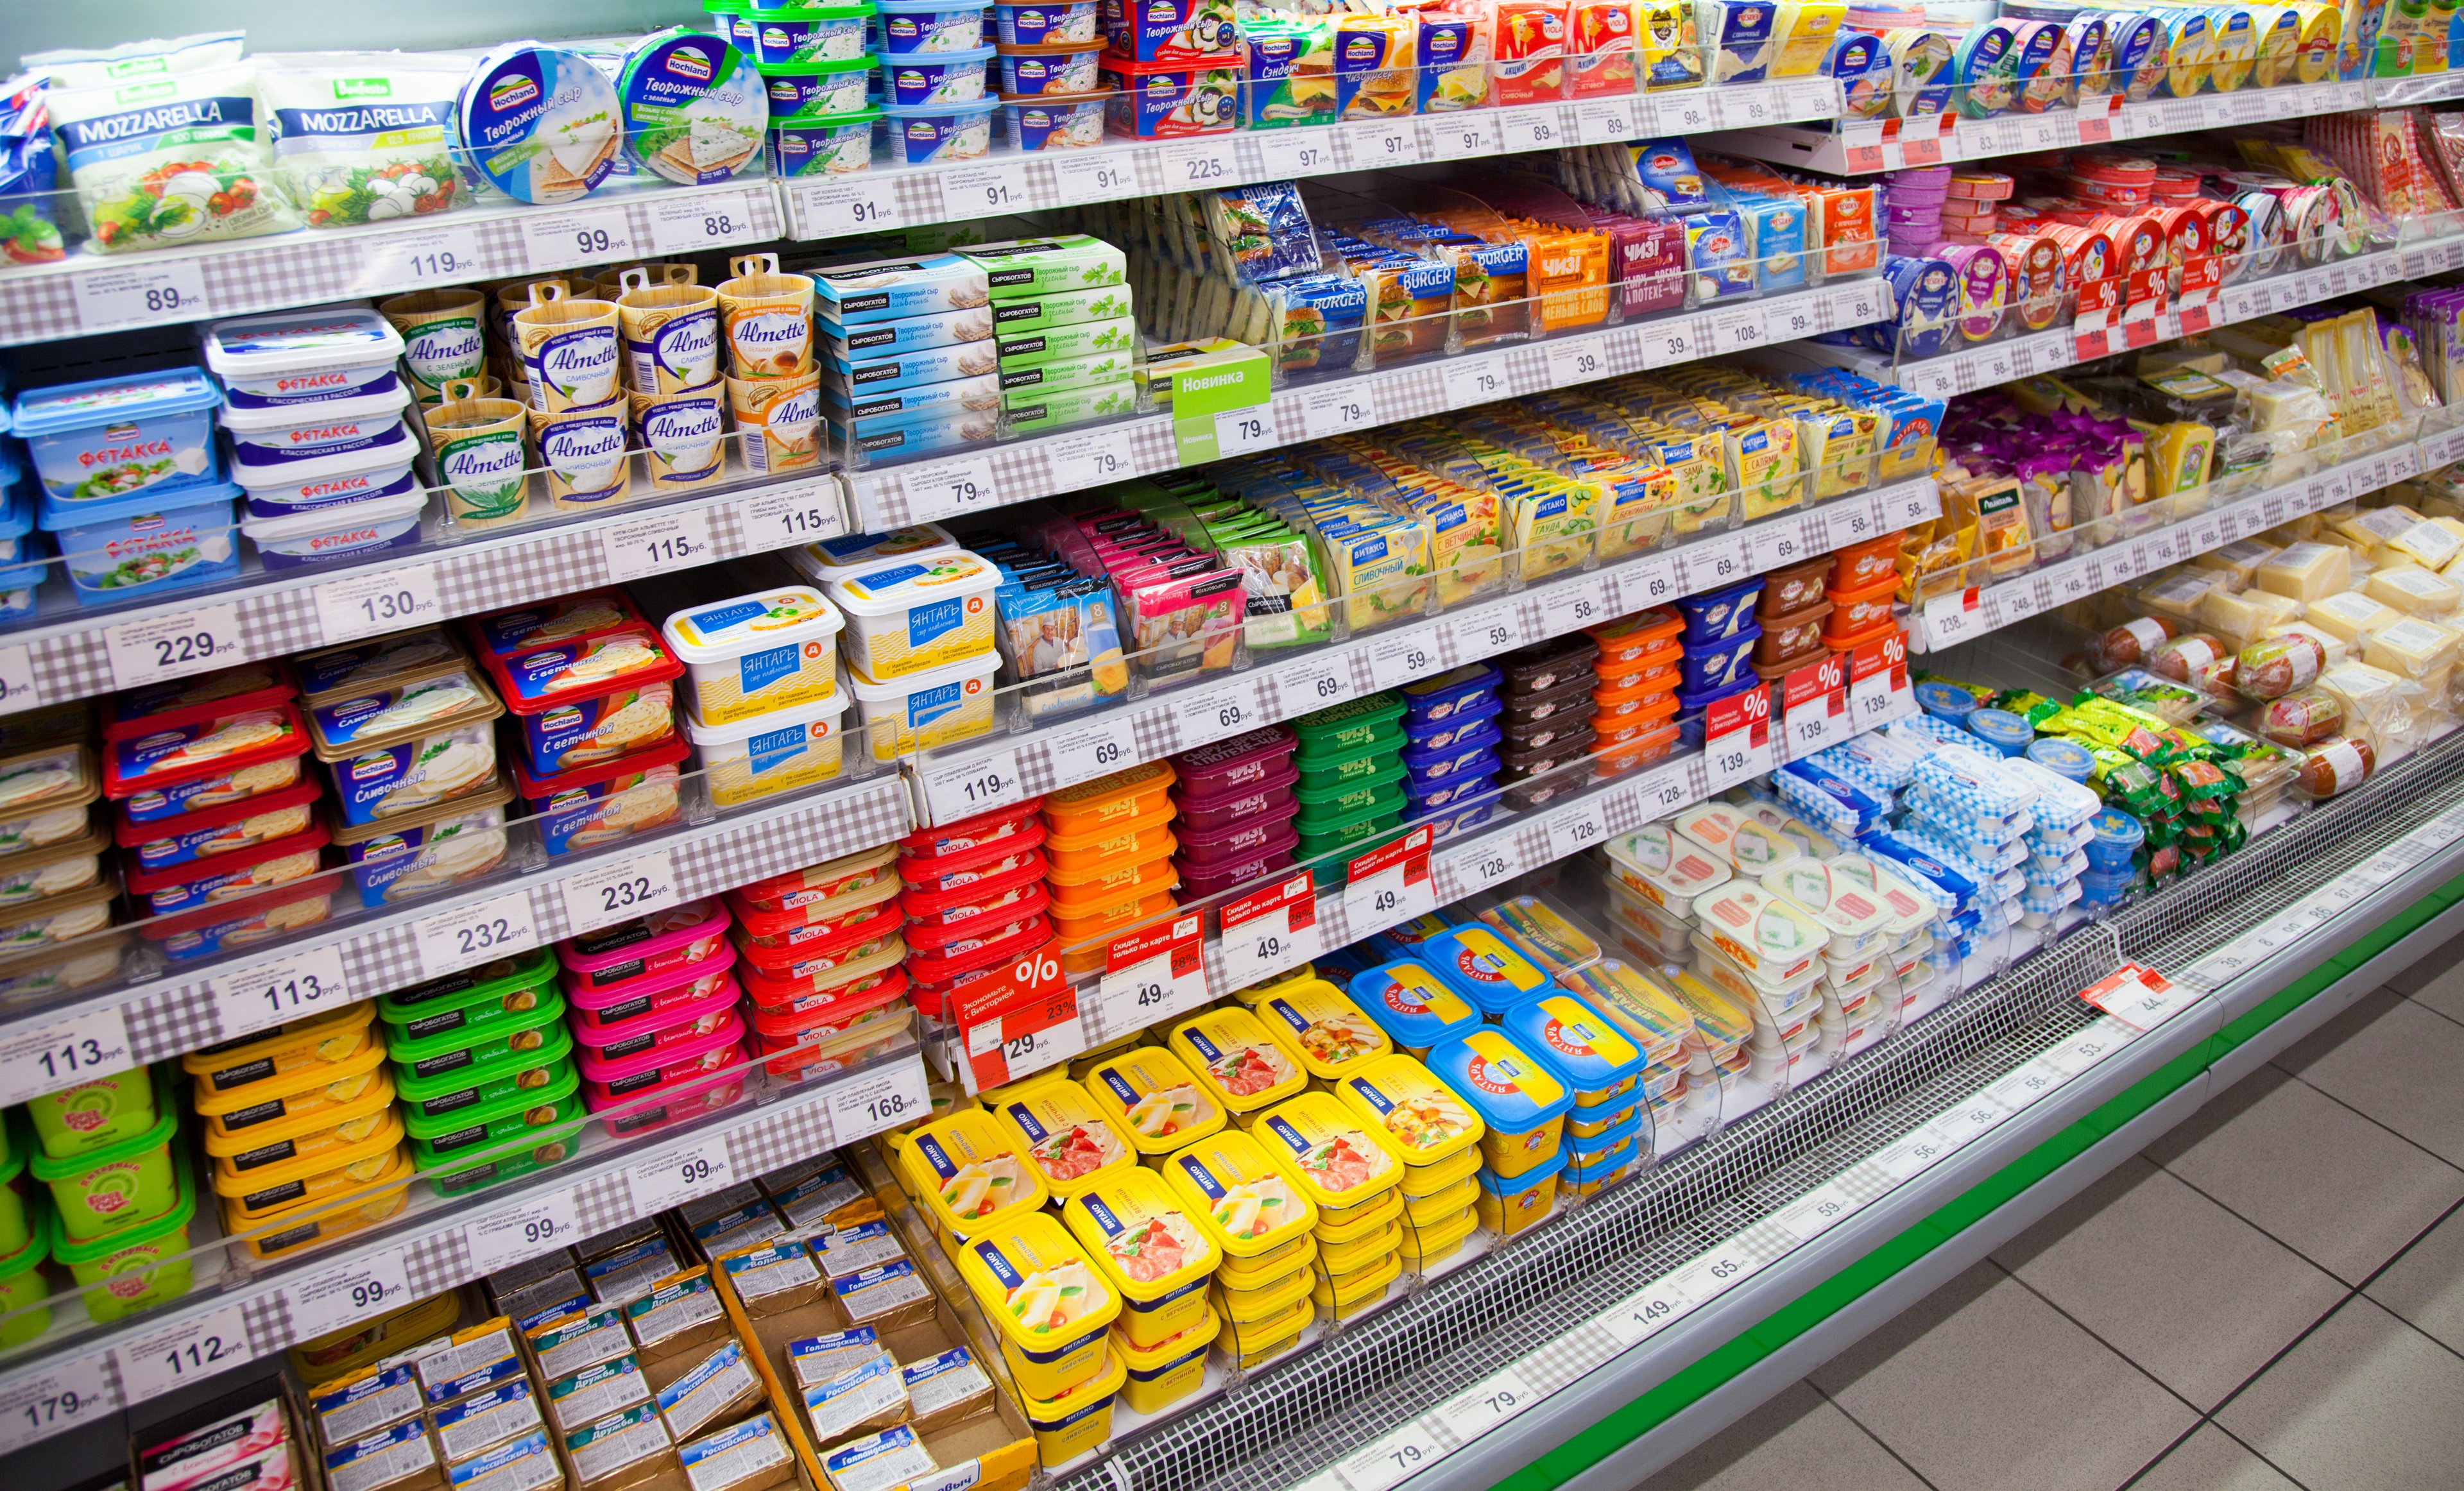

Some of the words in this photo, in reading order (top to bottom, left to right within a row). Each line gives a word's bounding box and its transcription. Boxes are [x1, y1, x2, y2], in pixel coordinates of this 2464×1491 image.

[1544, 26, 1562, 35] VIOLA
[668, 59, 710, 79] Hochland
[1262, 62, 1299, 78] Сэндвич
[1504, 62, 1527, 76] АКЦИЯ!
[646, 77, 717, 99] Творожный
[718, 89, 744, 106] сыр
[801, 79, 847, 95] Творожный
[848, 76, 864, 88] сыр
[1501, 90, 1534, 100] СЛИВОЧНЫЙ
[493, 87, 536, 110] Hochland
[648, 94, 677, 104] зеленью
[79, 102, 223, 144] MOZZARELLA
[301, 106, 437, 132] MOZZARELLA
[483, 98, 556, 142] Творожный
[557, 85, 583, 108] сыр
[1464, 133, 1479, 149] 97
[1534, 126, 1549, 141] 89
[1186, 158, 1222, 180] 225
[1299, 150, 1317, 167] 97
[853, 201, 877, 223] 91
[706, 215, 732, 236] 88
[578, 229, 609, 253] 99
[1625, 241, 1659, 260] ЧИЗ!
[411, 251, 455, 277] 119
[992, 272, 1032, 283] СЫРОБОГАТОВ
[1036, 266, 1065, 276] Творожный
[1066, 265, 1079, 274] сыр
[1542, 254, 1580, 276] ЧИЗ!
[1403, 268, 1451, 290] BURGER
[146, 287, 180, 311] 89
[844, 297, 886, 309] СЫРОБОГАТОВ
[734, 320, 806, 343] Almette
[413, 336, 481, 361] Almette
[547, 336, 619, 370] Almette
[1668, 338, 1684, 355] 39
[436, 359, 471, 372] ЗЕЛЕНЬЮ
[566, 366, 610, 383] СЛИВОЧНЫЙ
[277, 373, 347, 392] ФЕТАКСА
[1183, 370, 1244, 393] Новинка
[1341, 404, 1359, 422] 79
[1183, 432, 1213, 446] Новинка
[1239, 418, 1261, 440] 79
[79, 440, 171, 467] ФЕТАКСА
[1751, 453, 1779, 470] САЛЯМИ
[952, 482, 977, 503] 79
[782, 509, 820, 534] 115
[1535, 521, 1560, 534] ГАУДА
[1438, 542, 1442, 552] С
[1445, 524, 1482, 548] ВЕТЧИНОЙ
[647, 536, 689, 564] 115
[1354, 541, 1385, 559] ВИТАКО
[1354, 559, 1403, 585] СЛИВОЧНЫЙ
[1650, 579, 1665, 595] 69
[362, 591, 415, 622] 130
[911, 604, 960, 629] ЯНТАРЬ
[1940, 616, 1961, 634] 238
[155, 632, 215, 667] 229
[524, 652, 567, 669] Hochland
[529, 672, 538, 681] С
[540, 654, 602, 677] ветчиной
[744, 649, 797, 674] ЯНТАРЬ
[1407, 652, 1425, 670] 59
[778, 694, 811, 706] растительных
[813, 689, 829, 699] жиров
[785, 690, 810, 702] содержит
[1220, 706, 1240, 727] 69
[1097, 743, 1118, 763] 69
[1720, 753, 1743, 774] 139
[354, 760, 394, 777] Hochland
[355, 770, 425, 803] Сливочный
[965, 774, 1000, 801] 119
[942, 840, 970, 853] VIOLA
[1480, 858, 1505, 879] 128
[601, 877, 652, 912] 232
[789, 892, 819, 906] VIOLA
[458, 917, 511, 955] 232
[1113, 936, 1140, 951] Скидка
[1113, 946, 1138, 960] только
[1139, 942, 1149, 952] по
[1151, 934, 1170, 948] карте
[595, 960, 641, 978] СЫРОБОГАТОВ
[1170, 952, 1198, 971] 28%
[265, 975, 321, 1011] 113
[963, 985, 1007, 1012] Экономьте
[970, 989, 1015, 1017] Викторией
[1138, 984, 1161, 1007] 49
[1047, 999, 1076, 1019] 23%
[996, 1034, 1034, 1063] 129
[868, 1094, 904, 1121] 168
[925, 1143, 948, 1169] ВИТАКО
[681, 1160, 708, 1185] 99
[1091, 1204, 1115, 1229] ВИТАКО
[1818, 1202, 1840, 1217] 59
[750, 1254, 783, 1268] Волна
[1711, 1260, 1740, 1281] 65
[848, 1269, 899, 1291] Голландский
[352, 1281, 384, 1308] 99
[1168, 1300, 1196, 1316] ВЕТЧИНОЙ
[1633, 1300, 1670, 1327] 149
[559, 1321, 598, 1342] Дружба
[166, 1336, 224, 1374] 112
[678, 1360, 724, 1399] Российский
[346, 1381, 384, 1402] Орбита
[24, 1391, 79, 1427] 179
[472, 1447, 529, 1476] Российский
[1390, 1445, 1422, 1470] 79
